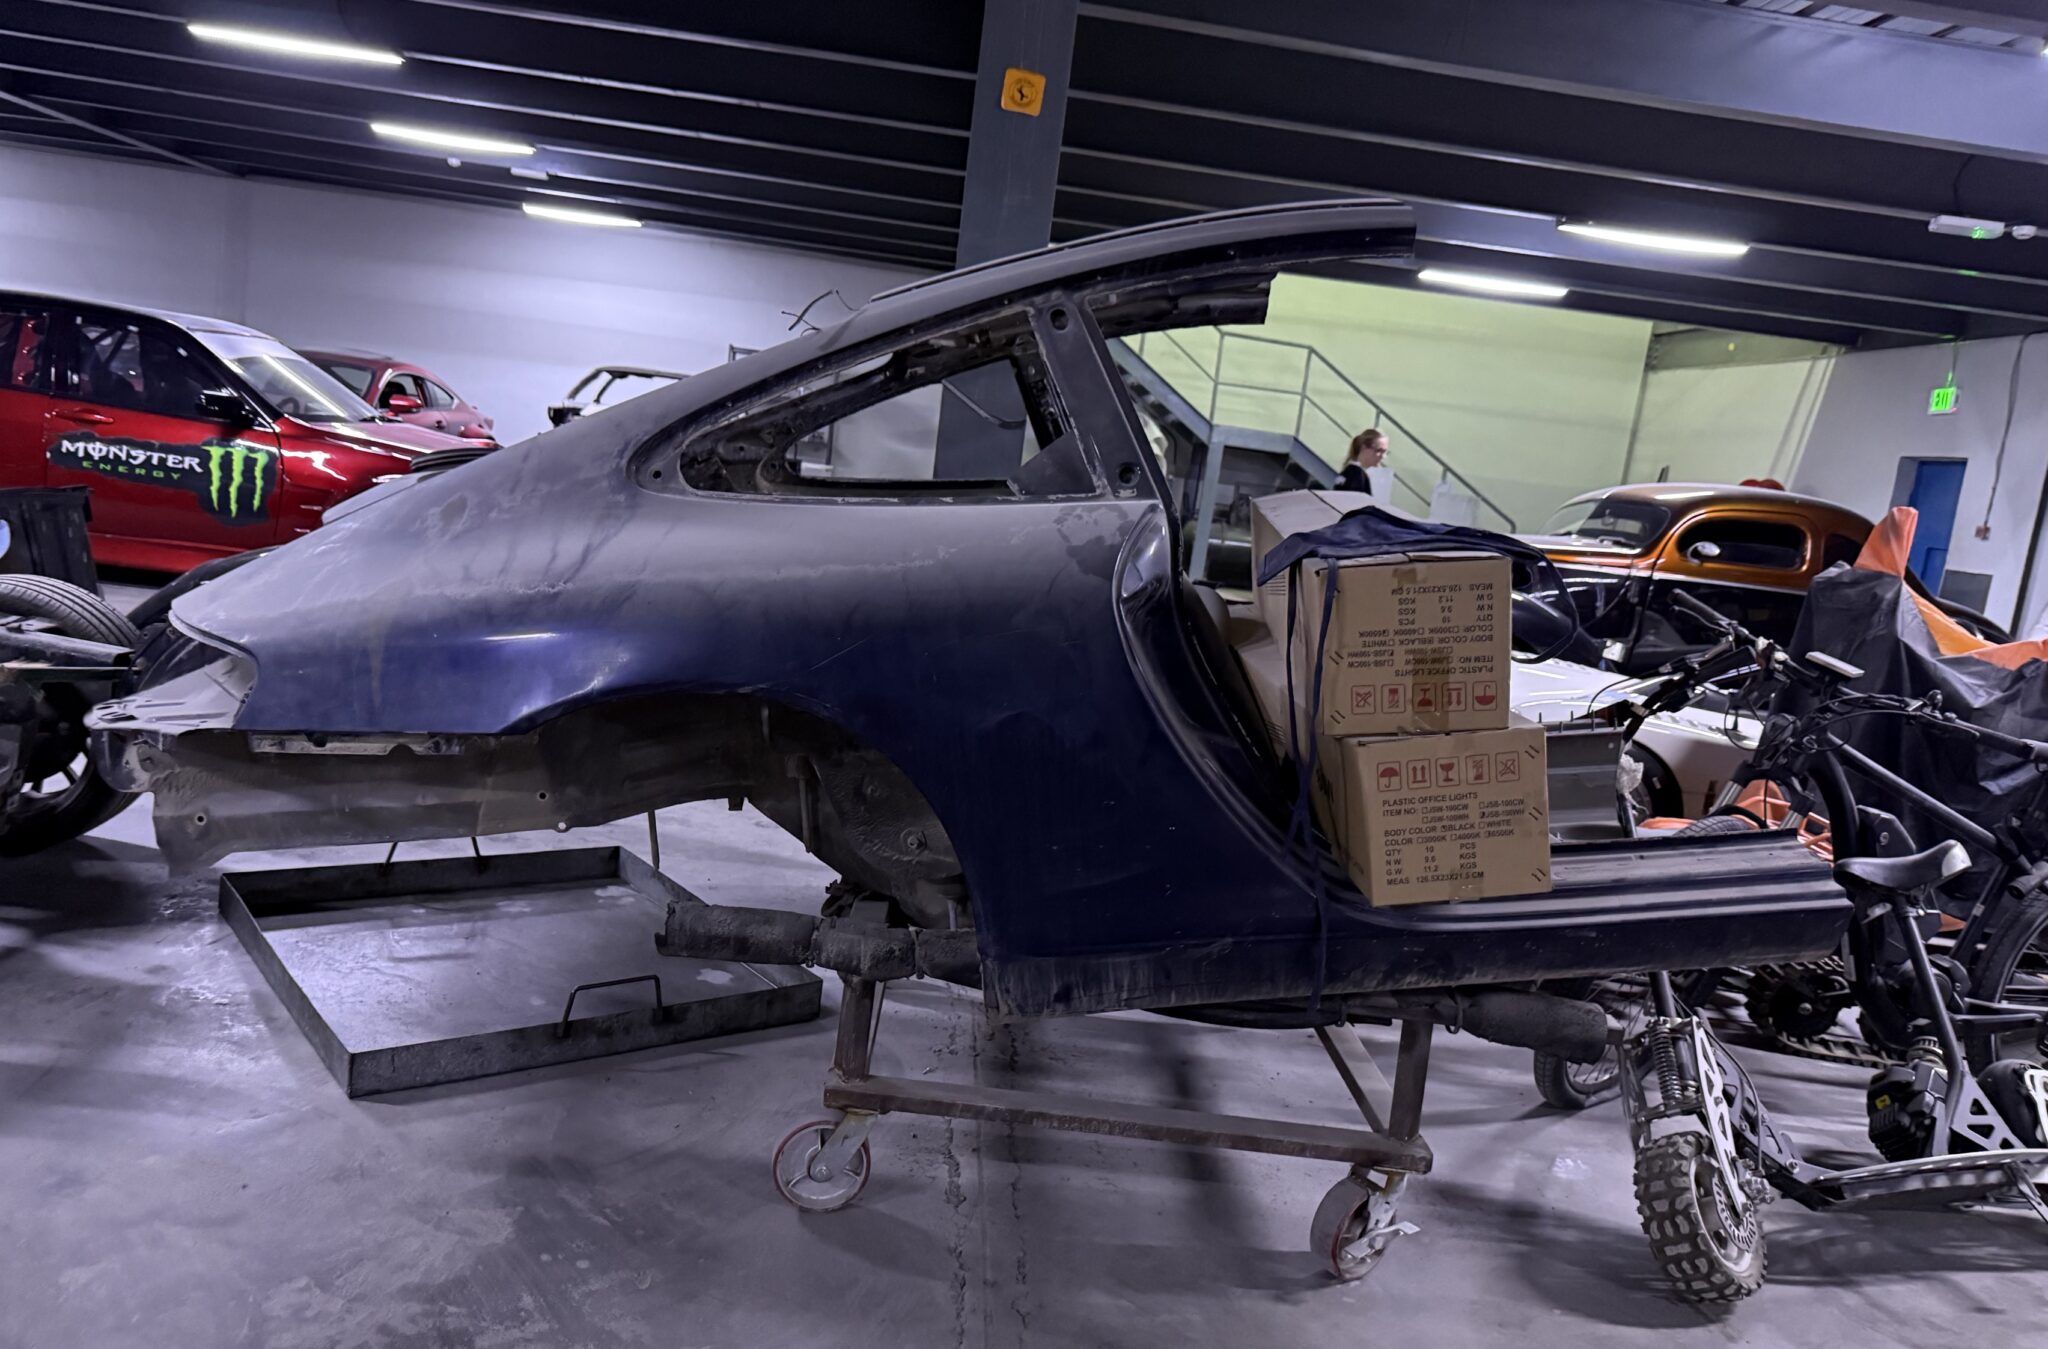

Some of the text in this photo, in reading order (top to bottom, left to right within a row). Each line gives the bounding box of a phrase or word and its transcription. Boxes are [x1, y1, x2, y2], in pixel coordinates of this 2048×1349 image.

[82, 461, 181, 480] ENERGY
[1399, 637, 1427, 645] BLACK
[1425, 667, 1456, 675] OFFICE
[1383, 792, 1478, 806] PLASTIC OFFICE LIGHTS
[1384, 829, 1407, 837] BODY
[1448, 823, 1475, 831] BLACK
[1487, 820, 1511, 828] WHITE
[1385, 849, 1401, 857] QTY
[1460, 842, 1476, 850] PCS
[1460, 852, 1476, 860] KGS
